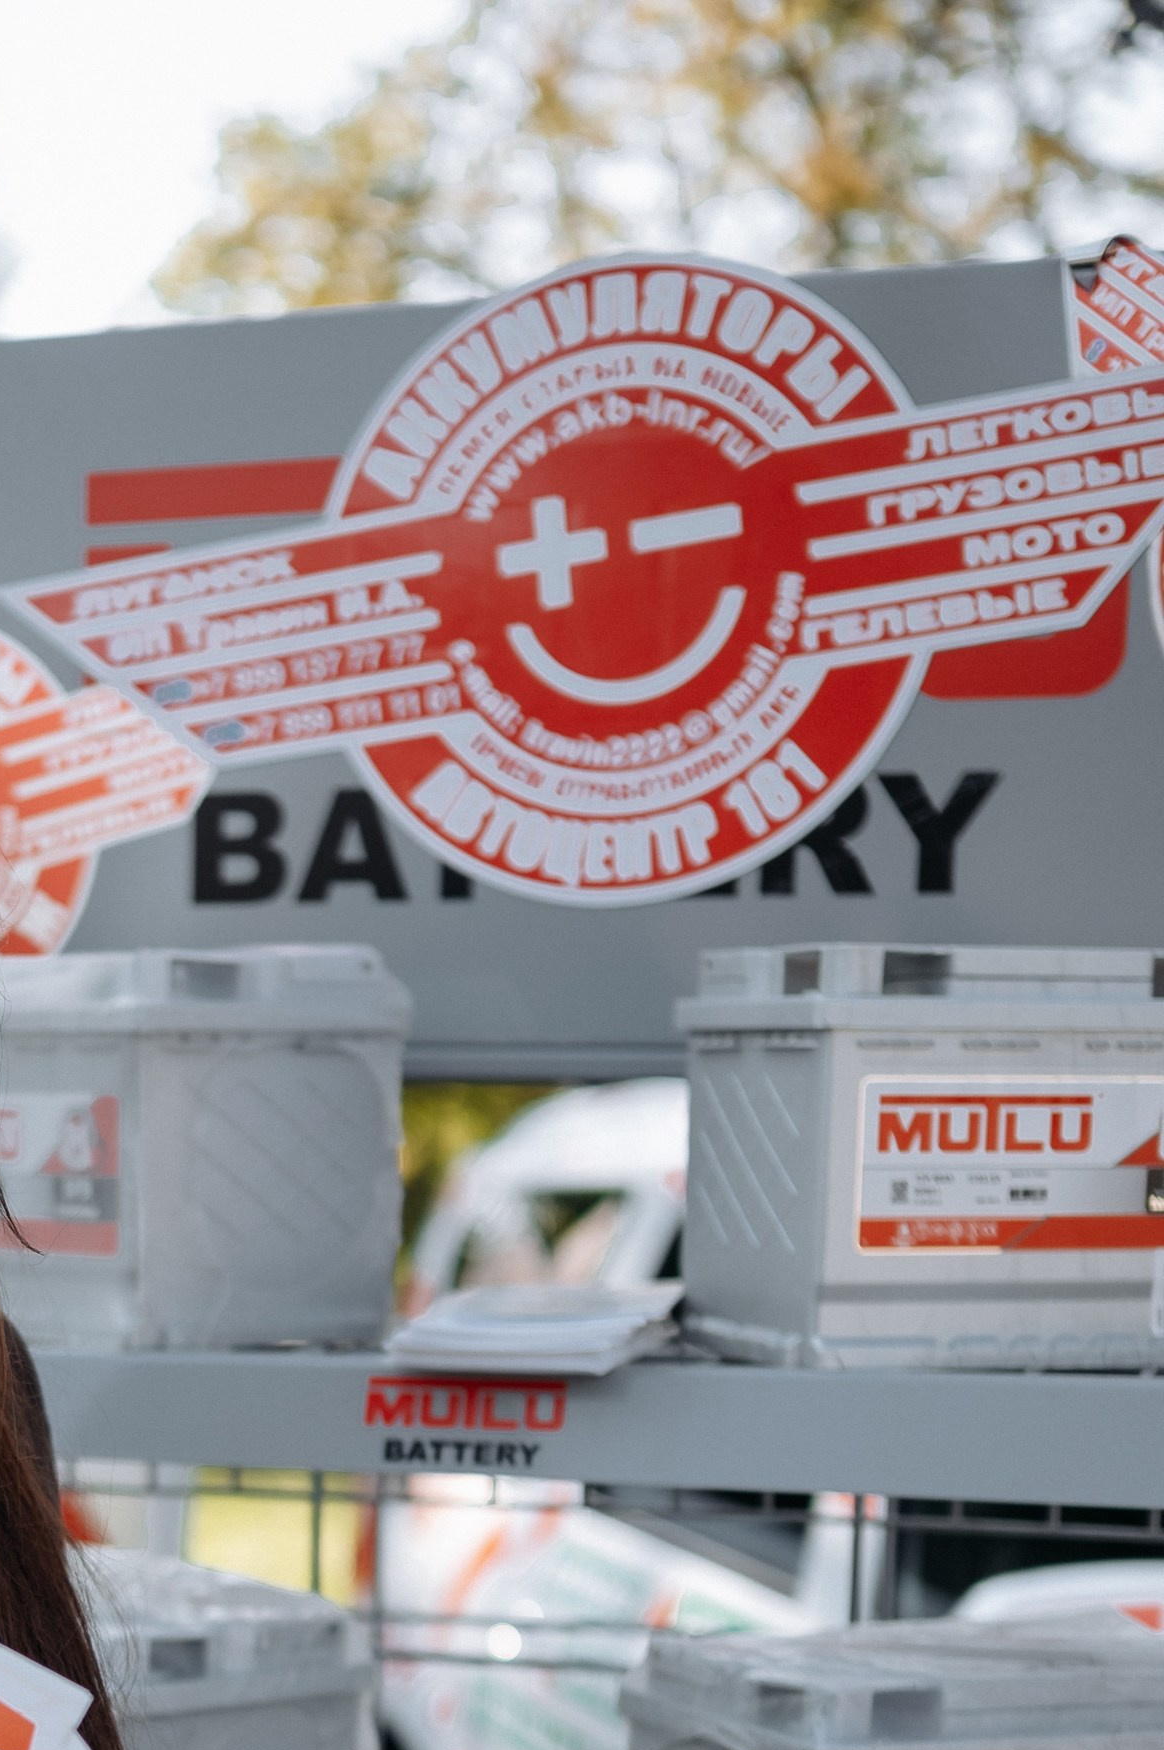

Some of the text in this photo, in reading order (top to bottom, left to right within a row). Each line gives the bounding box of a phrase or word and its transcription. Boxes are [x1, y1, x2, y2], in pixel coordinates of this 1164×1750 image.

[1090, 282, 1136, 325] ИП
[363, 271, 872, 499] АККУМУЛЯТОРЫ
[653, 357, 688, 380] НА
[699, 365, 792, 435] НОВЫЕ
[905, 387, 1164, 461] ЛЕГКОВЫ
[962, 512, 1126, 568] МОТО
[801, 578, 1069, 650] ГЕЛЕВЫЕ
[414, 739, 827, 888] АВТОЦЕНТР 181
[878, 1094, 1093, 1154] MUTLU
[364, 1376, 567, 1432] MUTLU
[384, 1439, 539, 1467] BATTERY
